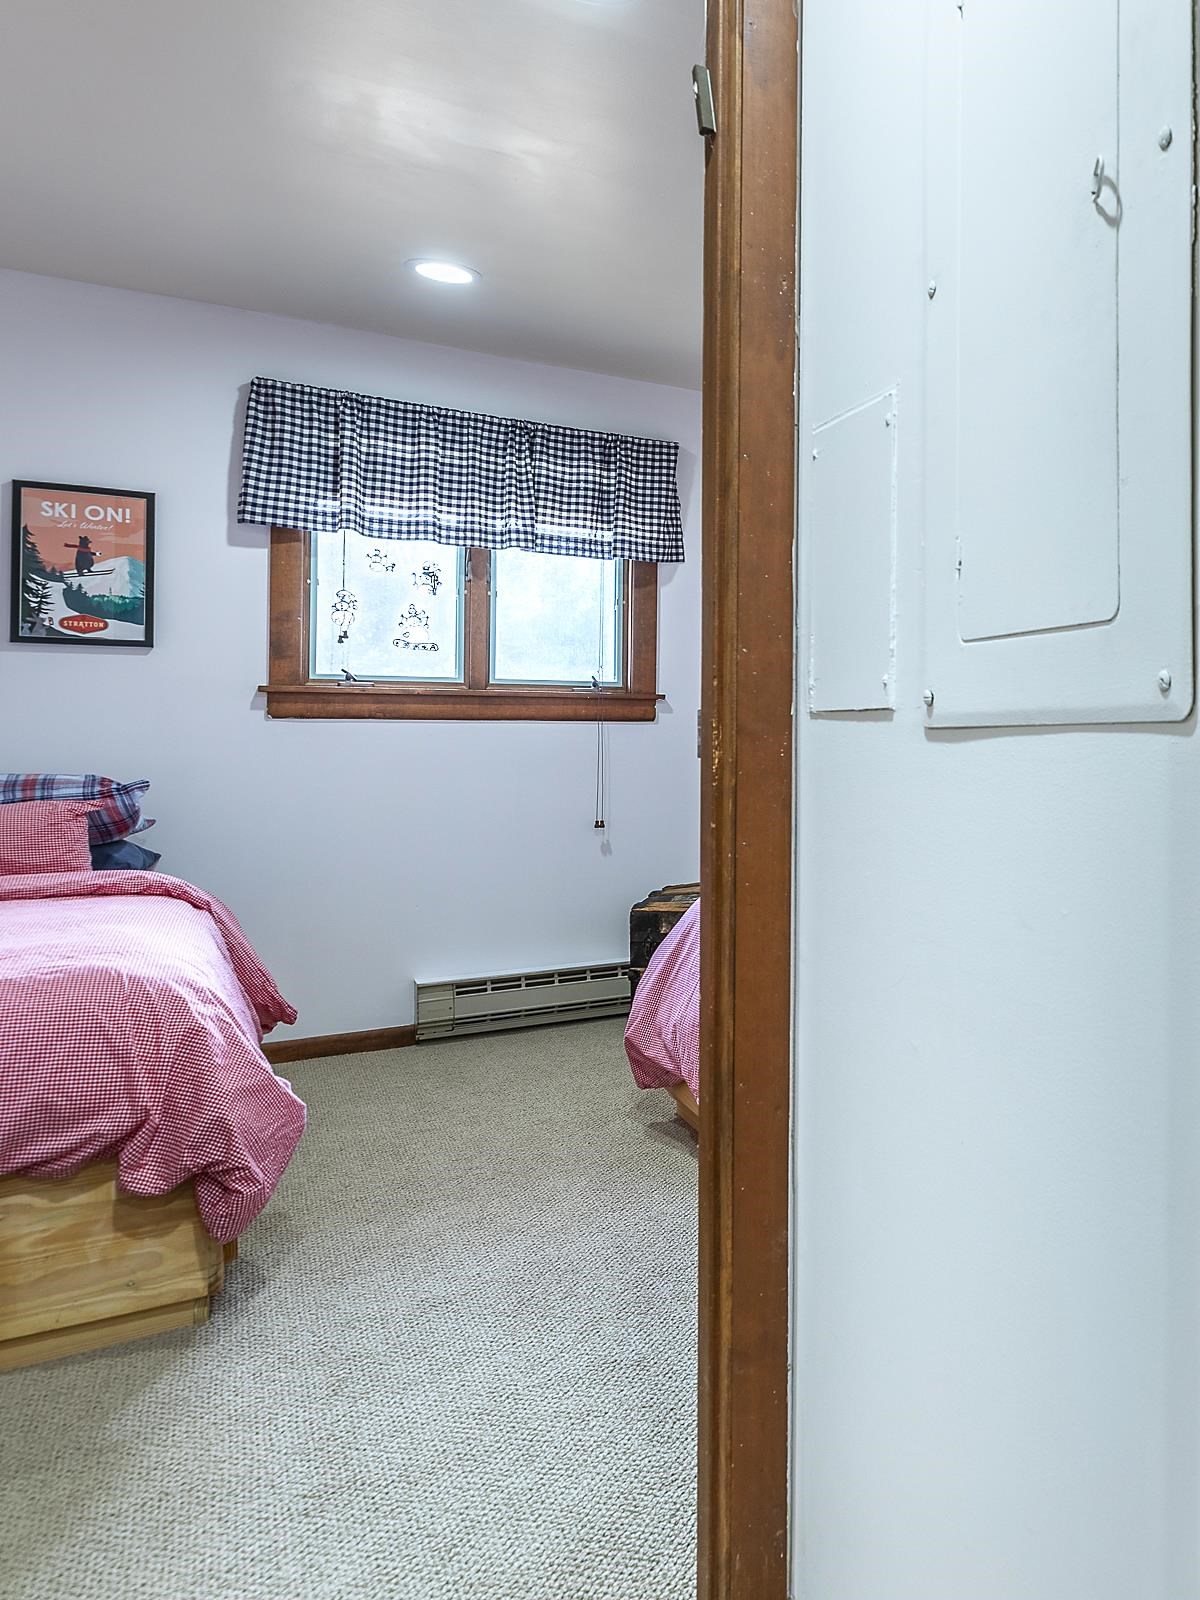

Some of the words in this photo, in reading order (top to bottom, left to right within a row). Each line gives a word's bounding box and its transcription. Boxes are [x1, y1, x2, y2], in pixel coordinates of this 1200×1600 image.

[41, 501, 77, 519] SKI
[84, 505, 131, 523] ON!
[63, 620, 104, 628] STRATTON
